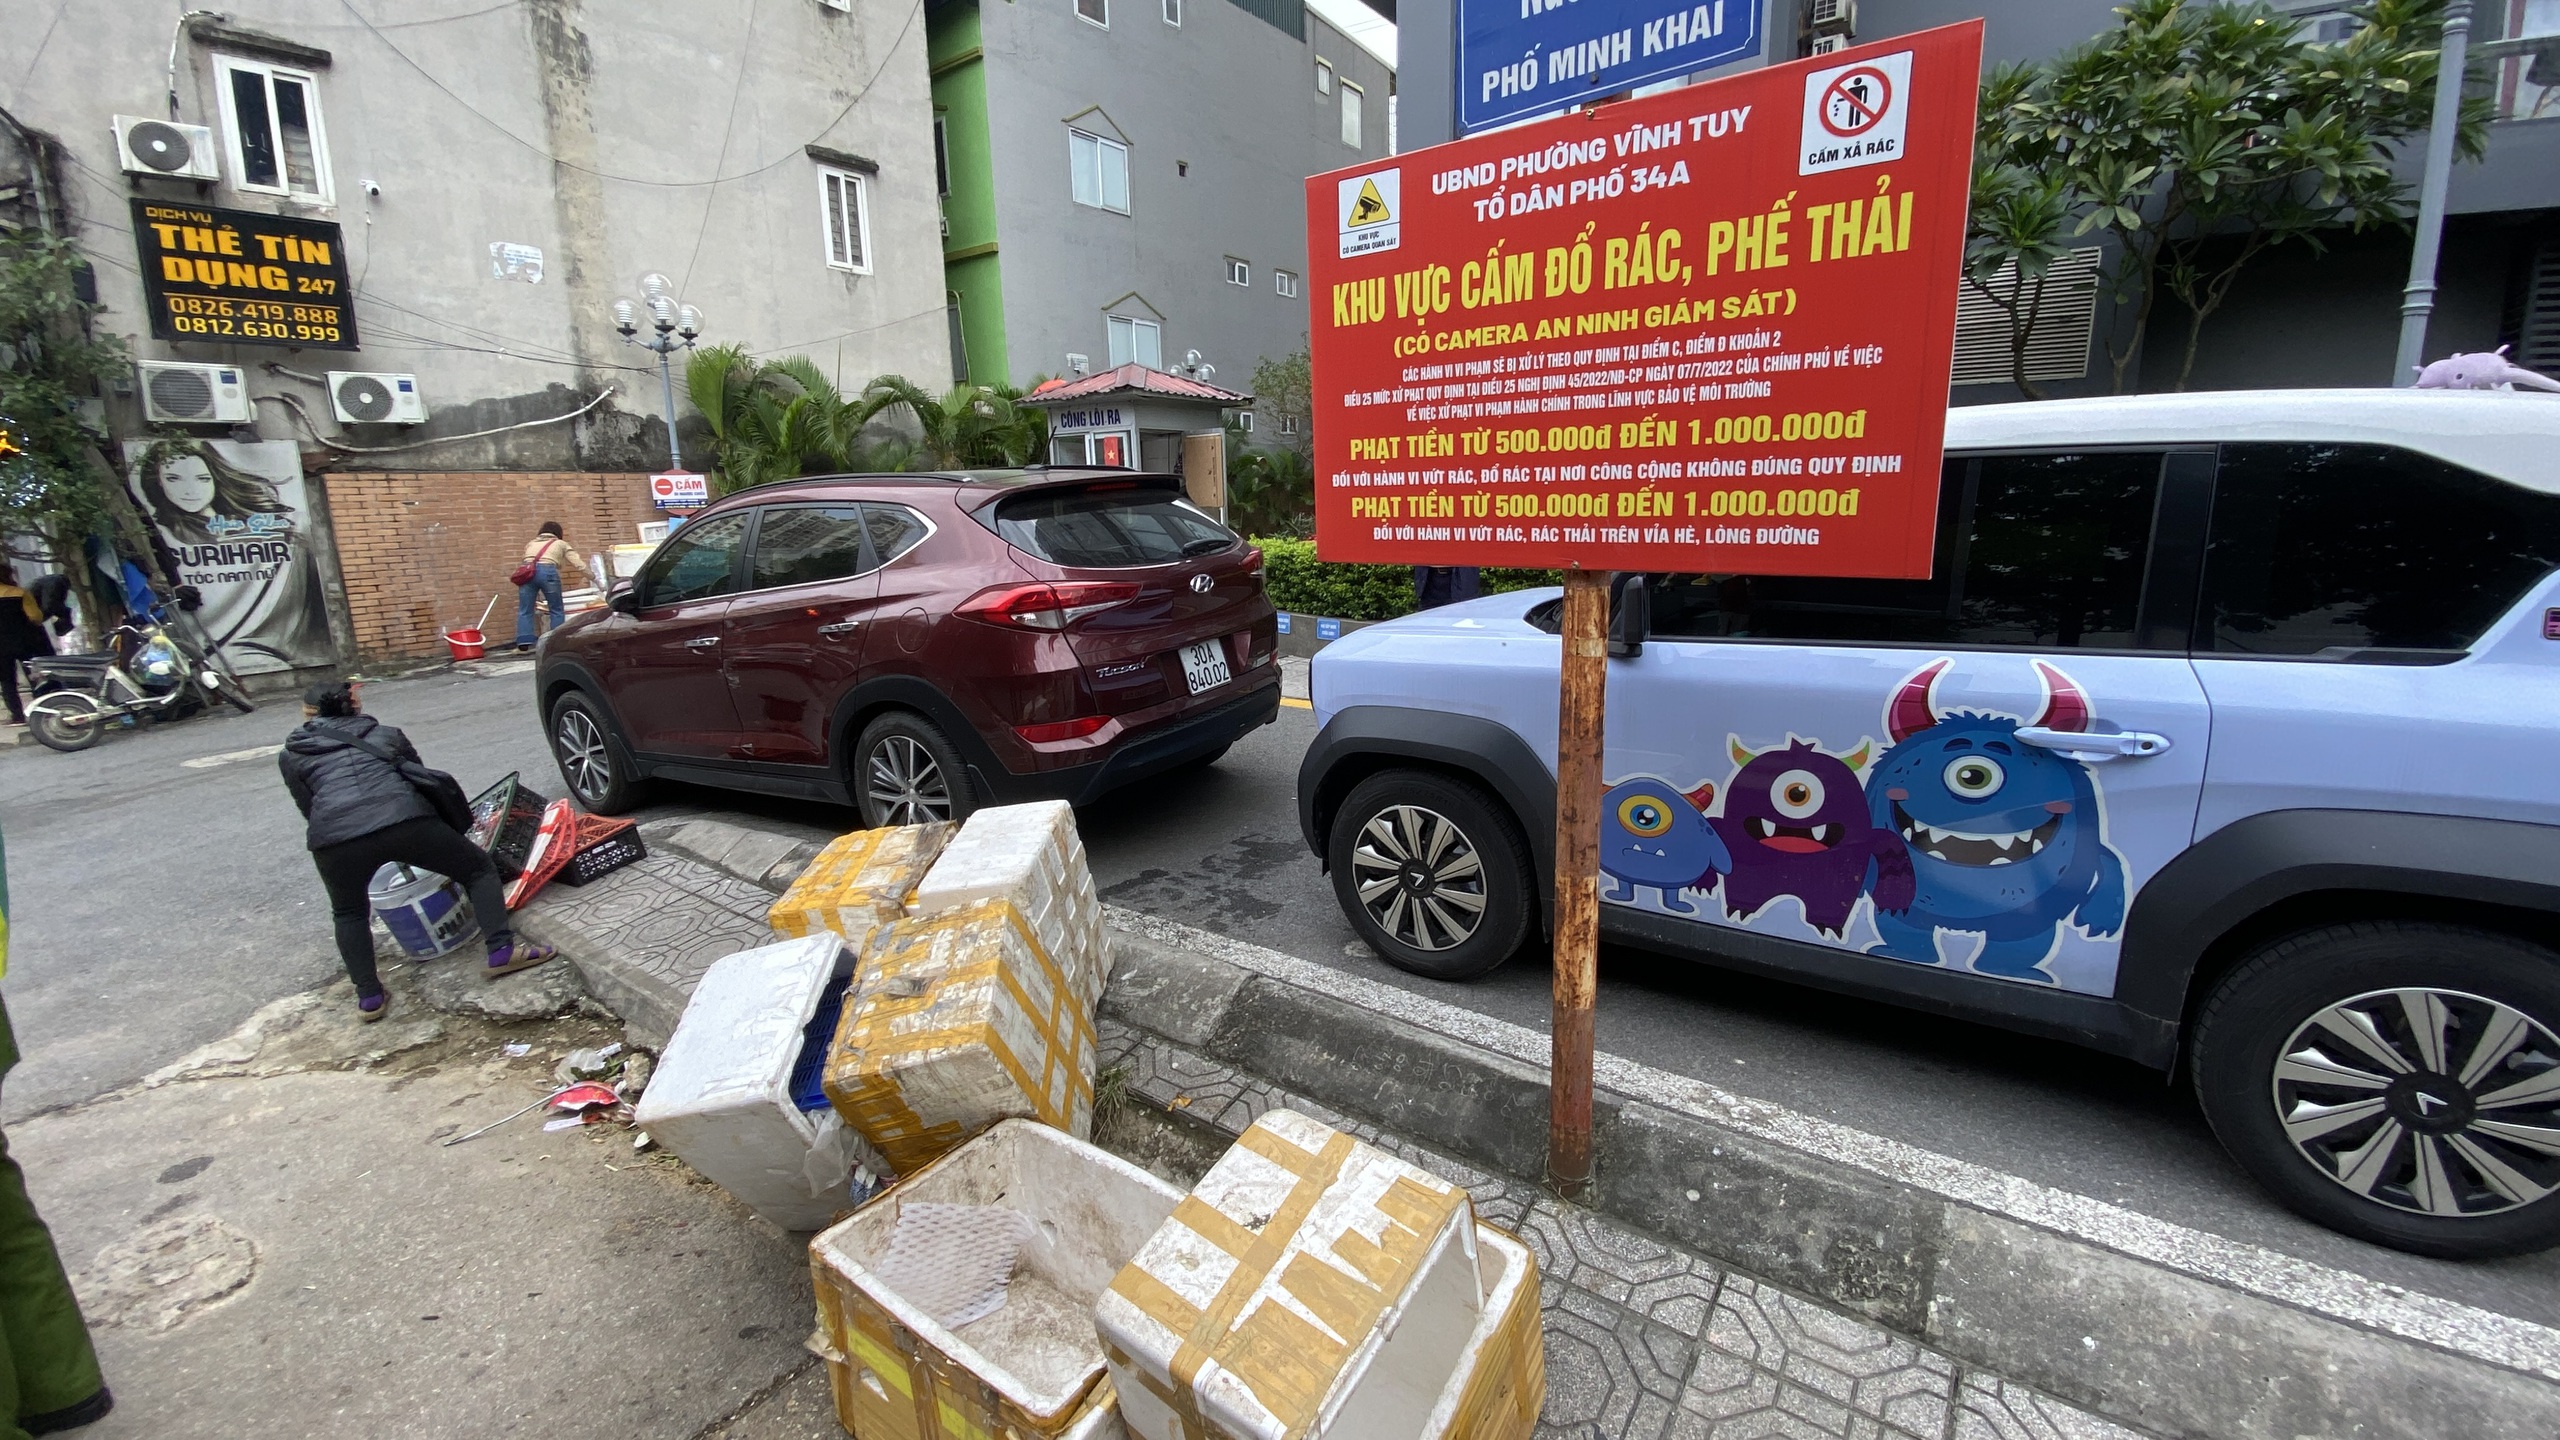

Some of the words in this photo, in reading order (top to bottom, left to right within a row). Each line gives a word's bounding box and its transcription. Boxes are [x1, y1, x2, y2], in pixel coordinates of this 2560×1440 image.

[1482, 43, 1541, 103] PHỐ
[1548, 28, 1632, 84] MINH
[1642, 0, 1724, 57] KHAI
[1432, 162, 1496, 195] UBND
[1500, 138, 1607, 182] PHƯỜNG
[1613, 120, 1681, 157] VĨNH
[1688, 105, 1752, 142] TUY
[1808, 146, 1839, 165] CẤM
[1843, 141, 1862, 160] XẢ
[1866, 138, 1895, 155] RÁC
[1473, 184, 1506, 222] TỔ
[1509, 183, 1564, 216] DÂN
[1569, 161, 1629, 204] PHỐ
[1630, 160, 1691, 194] 34A
[145, 206, 187, 221] DỊCH
[189, 211, 212, 225] VỤ
[150, 222, 243, 256] THẺ
[254, 234, 332, 266] TÍN
[1333, 276, 1386, 328] KHU
[1394, 263, 1451, 327] VỰC
[1460, 238, 1535, 310] CẤM
[1544, 220, 1596, 298] ĐỔ
[1604, 221, 1692, 291] RÁC,
[1706, 190, 1798, 276] PHẾ
[1806, 174, 1914, 263] THẢI
[1342, 246, 1349, 254] CÓ
[1350, 243, 1370, 253] CAMERA
[1371, 240, 1386, 249] QUAN
[1386, 237, 1396, 246] SÁT
[1358, 233, 1369, 241] KHU
[1370, 231, 1380, 239] VỰC
[161, 255, 290, 291] DỤNG
[297, 277, 336, 296] 247
[169, 297, 338, 325] 0826.419.888
[1394, 330, 1431, 358] (CÓ
[1434, 323, 1529, 352] CAMERA
[1534, 317, 1571, 340] AN
[1576, 308, 1639, 336] NINH
[1644, 297, 1716, 328] GIÁM
[174, 316, 341, 342] 0812.630.999
[1402, 366, 1419, 382] CÁC
[1420, 364, 1442, 380] HÀNH
[1444, 364, 1453, 378] VI
[1455, 363, 1463, 377] VI
[1465, 360, 1491, 377] PHẠM
[1493, 356, 1506, 373] SẼ
[1507, 357, 1516, 374] BỊ
[1518, 353, 1532, 371] XỬ
[1533, 352, 1544, 369] LÝ
[1547, 351, 1571, 368] THEO
[1573, 349, 1593, 367] QUY
[1595, 347, 1620, 365] ĐỊNH
[1623, 345, 1639, 363] TẠI
[1642, 337, 1669, 359] ĐIỂM
[1672, 340, 1683, 357] C,
[1686, 332, 1715, 355] ĐIỂM
[1718, 336, 1727, 352] Đ
[1729, 327, 1770, 351] KHOẢN
[1773, 331, 1782, 347] 2
[1345, 390, 1361, 407] ĐIỀU
[1362, 392, 1372, 406] 25
[1373, 388, 1390, 404] MỨC
[1392, 386, 1404, 403] XỬ
[1405, 387, 1424, 404] PHẠT
[1426, 386, 1442, 401] QUY
[1444, 383, 1464, 401] ĐỊNH
[1467, 382, 1480, 399] TẠI
[1482, 378, 1502, 395] ĐIỀU
[1505, 379, 1516, 393] 25
[1518, 377, 1540, 394] NGHỊ
[1543, 374, 1566, 393] ĐỊNH
[1568, 368, 1643, 388] 45/2022/NĐ-CP
[1645, 364, 1675, 382] NGÀY
[1677, 360, 1733, 379] 07/7/2022
[1736, 353, 1761, 374] CỦA
[1763, 354, 1801, 372] CHÍNH
[1803, 346, 1830, 369] PHỦ
[1834, 344, 1850, 366] VỀ
[1853, 346, 1884, 368] VIỆC
[1107, 409, 1121, 425] RA
[1406, 404, 1417, 421] VỀ
[1419, 404, 1437, 423] VIỆC
[1438, 402, 1450, 419] XỬ
[1451, 404, 1472, 420] PHẠT
[1475, 403, 1484, 417] VI
[1486, 401, 1512, 418] PHẠM
[1514, 397, 1539, 414] HÀNH
[1541, 394, 1570, 412] CHÍNH
[1573, 393, 1605, 410] TRONG
[1608, 390, 1632, 407] LĨNH
[1634, 389, 1655, 409] VỰC
[1658, 383, 1680, 404] BẢO
[1682, 384, 1697, 404] VỆ
[1700, 382, 1721, 401] MÔI
[1724, 380, 1771, 399] TRƯỜNG
[1350, 437, 1400, 463] PHẠT
[1406, 427, 1454, 457] TIỀN
[1460, 426, 1491, 455] TỪ
[1495, 424, 1612, 454] 500.000đ
[1620, 413, 1677, 448] ĐẾN
[1688, 410, 1867, 445] 1.000.000đ
[675, 478, 702, 490] CẤM
[1332, 469, 1350, 487] ĐỐI
[1353, 470, 1371, 486] VỚI
[1373, 470, 1405, 486] HÀNH
[1408, 471, 1420, 485] VI
[1422, 468, 1445, 484] VỨT
[1448, 467, 1477, 485] RÁC,
[1480, 464, 1500, 483] ĐỔ
[1502, 465, 1530, 482] RÁC
[1534, 467, 1556, 484] TẠI
[1560, 464, 1586, 481] NƠI
[1590, 462, 1632, 480] CÔNG
[1636, 460, 1682, 482] CỘNG
[1686, 458, 1746, 477] KHÔNG
[1751, 457, 1802, 475] ĐÚNG
[1808, 457, 1847, 476] QUY
[1851, 455, 1901, 476] ĐỊNH
[1351, 496, 1401, 522] PHẠT
[1407, 489, 1454, 517] TIỀN
[1460, 490, 1491, 517] TỪ
[1495, 493, 1610, 517] 500.000đ
[1616, 484, 1674, 516] ĐẾN
[1684, 488, 1860, 516] 1.000.000đ
[1373, 523, 1393, 540] ĐỐI
[1396, 524, 1414, 540] VỚI
[1417, 524, 1450, 540] HÀNH
[1454, 527, 1466, 541] VI
[1469, 525, 1493, 541] VỨT
[1496, 525, 1527, 543] RÁC,
[1530, 525, 1559, 542] RÁC
[1563, 523, 1596, 542] THẢI
[1600, 525, 1639, 543] TRÊN
[1644, 523, 1669, 543] VỈA
[1674, 525, 1700, 545] HÈ,
[1705, 524, 1750, 544] LÒNG
[1756, 524, 1820, 545] ĐƯỜNG
[1190, 643, 1215, 666] 30A
[1188, 662, 1229, 692] 840.02
